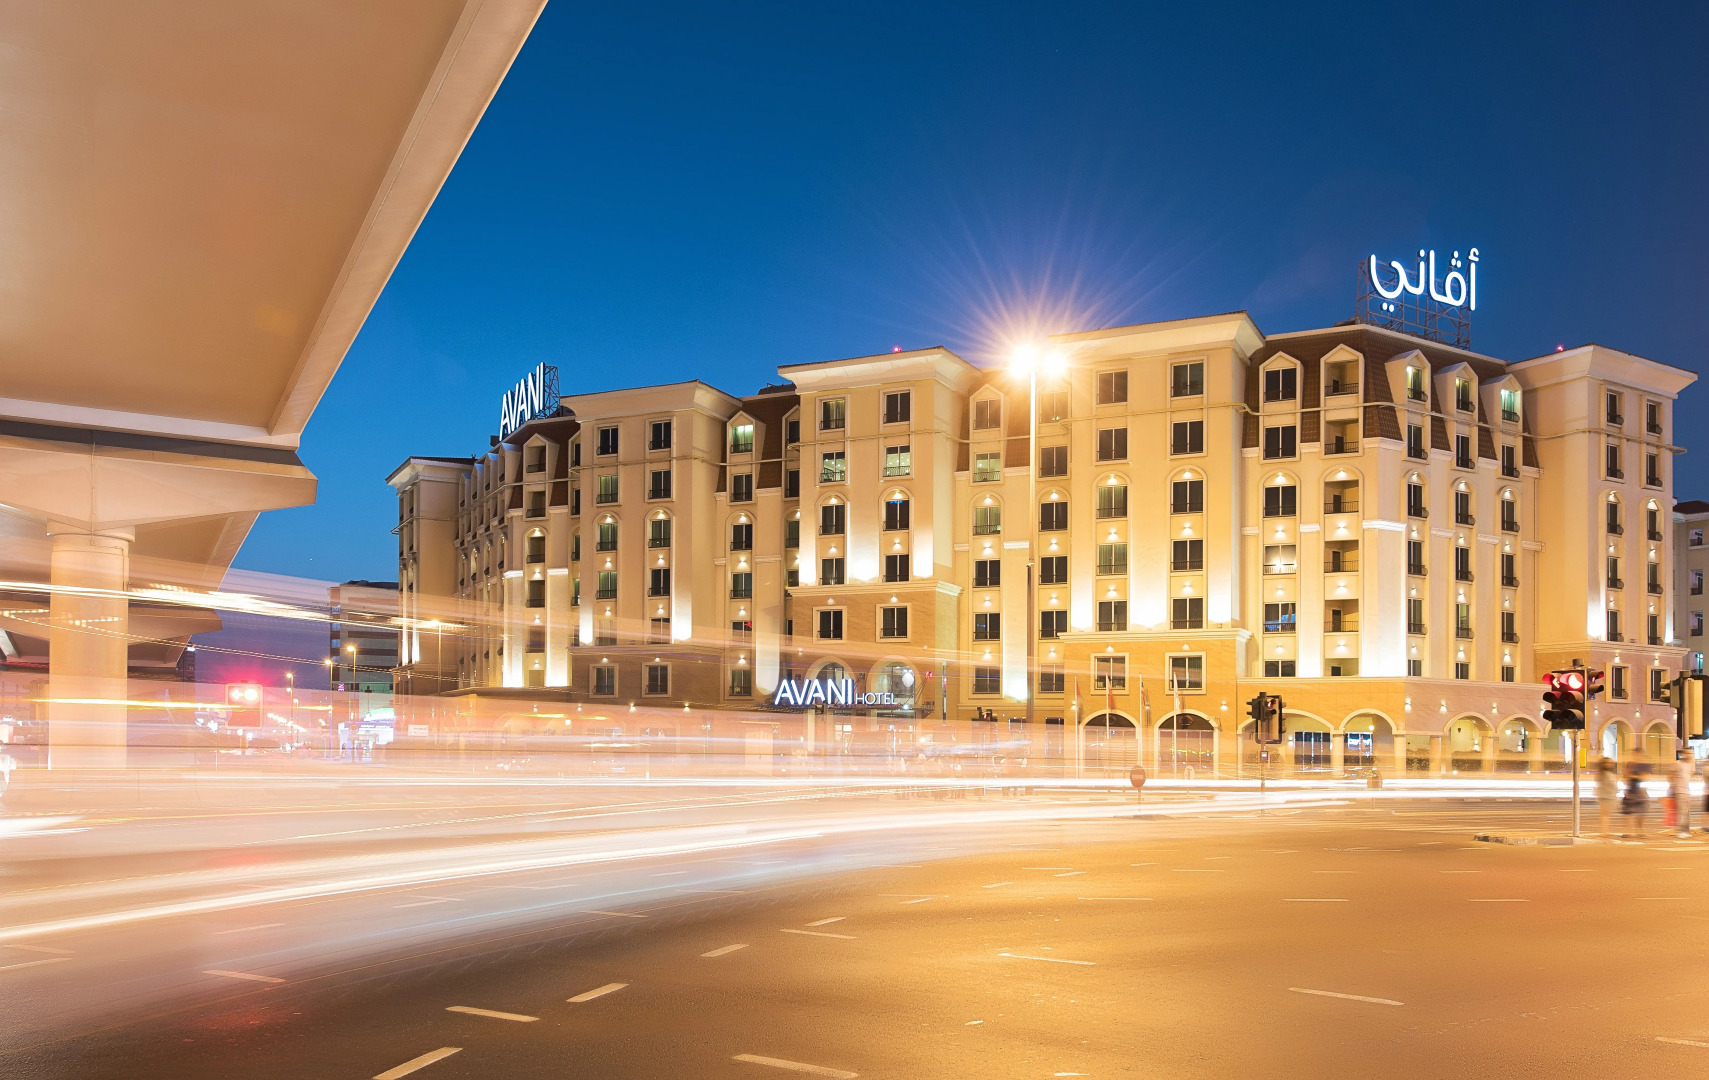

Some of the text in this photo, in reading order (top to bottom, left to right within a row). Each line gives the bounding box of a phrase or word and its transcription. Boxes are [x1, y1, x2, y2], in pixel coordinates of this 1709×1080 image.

[499, 361, 544, 441] AVANI
[774, 678, 898, 705] AVANI HOTEL
